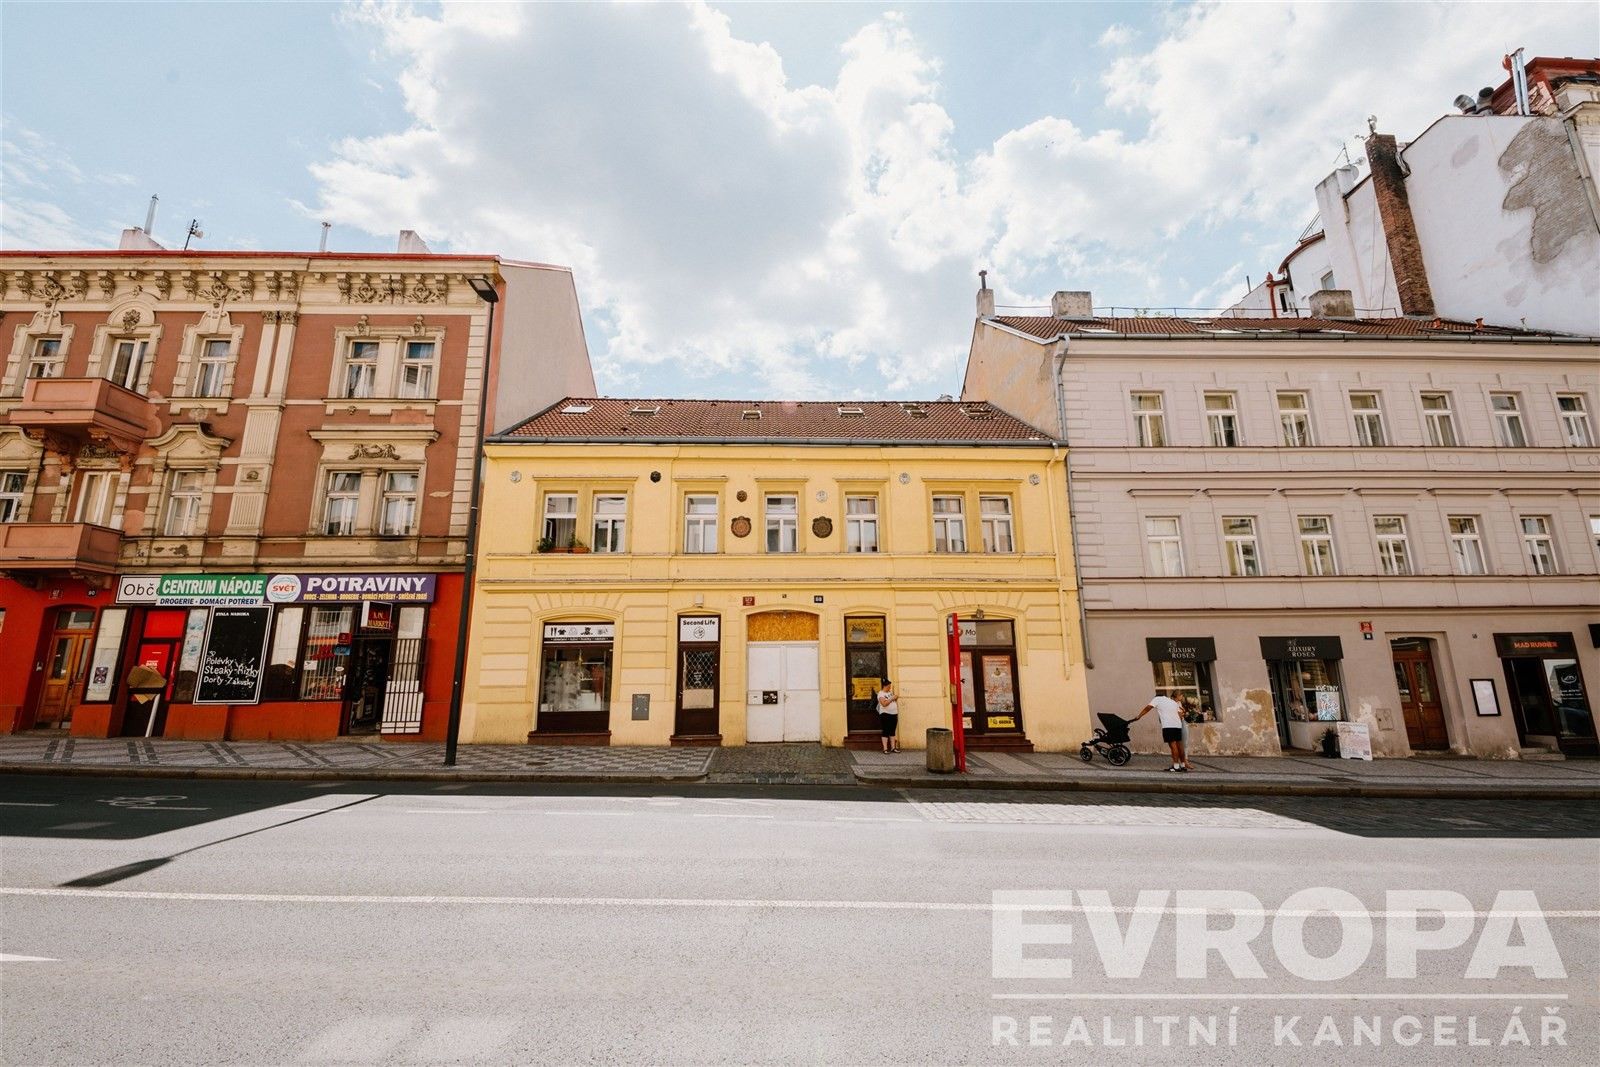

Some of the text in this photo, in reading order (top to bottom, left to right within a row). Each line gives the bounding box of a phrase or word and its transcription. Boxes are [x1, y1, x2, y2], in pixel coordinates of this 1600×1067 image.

[124, 583, 159, 596] Obč
[162, 577, 264, 594] CENTRUM NÁPOJE
[307, 578, 427, 592] POTRAVINY
